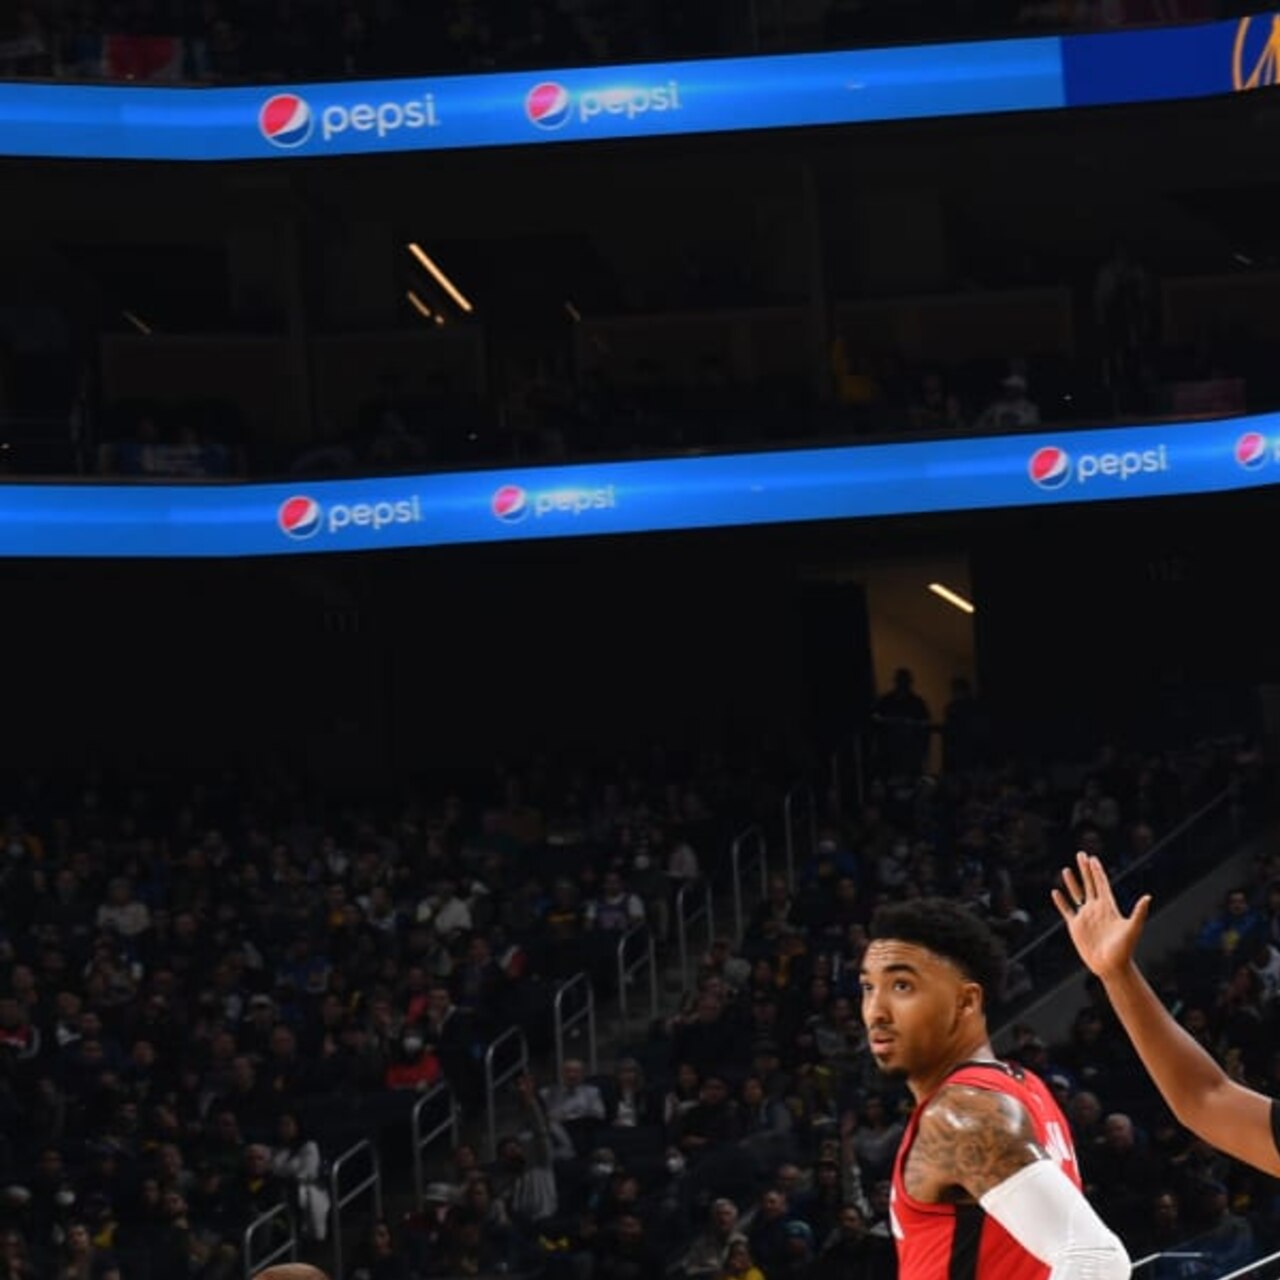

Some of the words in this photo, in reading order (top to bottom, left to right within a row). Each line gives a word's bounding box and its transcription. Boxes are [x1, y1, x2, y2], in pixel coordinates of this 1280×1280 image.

[321, 93, 437, 142] pepsi
[579, 82, 682, 122] pepsi
[1076, 443, 1168, 485] pepsi
[328, 494, 421, 535] pepsi
[533, 485, 616, 516] pepsi
